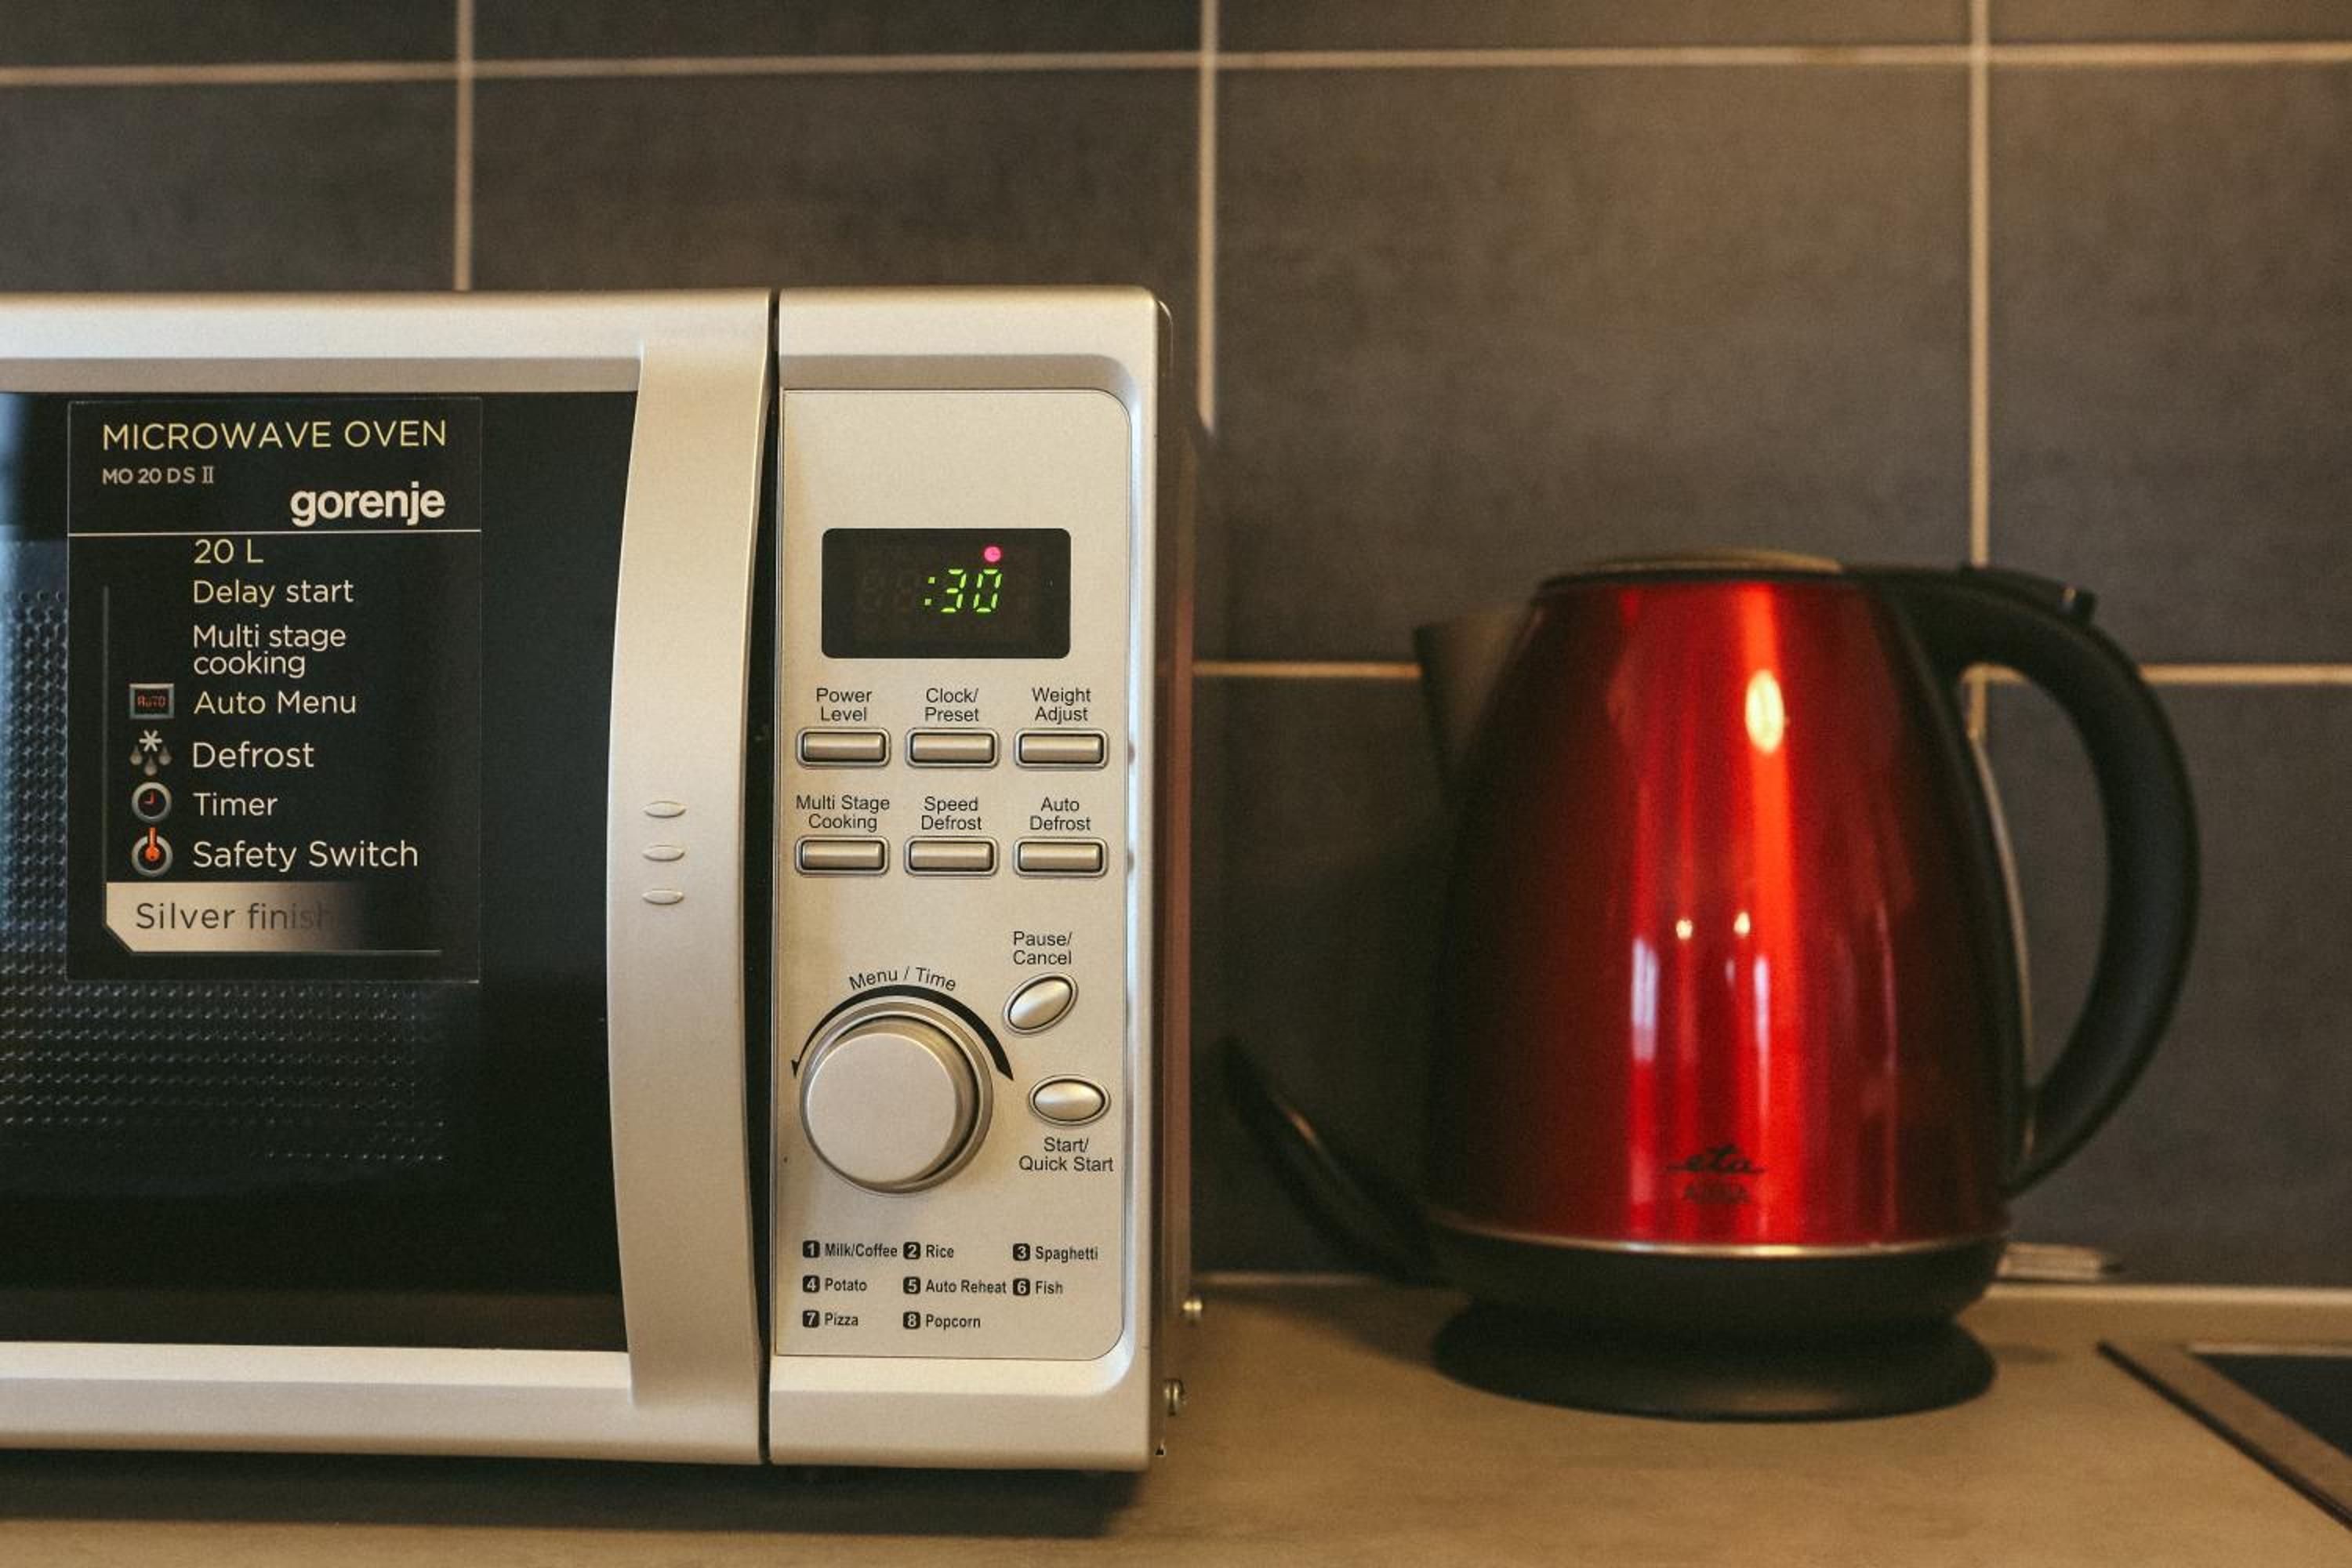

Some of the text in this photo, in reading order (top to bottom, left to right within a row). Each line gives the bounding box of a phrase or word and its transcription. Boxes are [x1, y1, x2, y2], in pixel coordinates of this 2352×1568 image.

[103, 419, 447, 451] MICROWAVE OVEN
[102, 468, 133, 485] MO
[137, 468, 162, 485] 20
[290, 481, 447, 527] gorenje
[194, 538, 264, 564] 20 L
[193, 579, 354, 608] Delay start
[193, 624, 347, 652] Multi stage
[193, 650, 306, 678] cooking
[194, 691, 358, 715] Auto Menu
[816, 688, 872, 703] Power
[926, 687, 979, 703] Clock/
[1032, 688, 1092, 706] Weight
[820, 706, 867, 722] Level
[924, 707, 980, 723] Preset
[1034, 707, 1089, 724] Adjust
[193, 742, 315, 769] Defrost
[193, 792, 278, 817] Timer
[796, 795, 891, 814] Multi Stage
[924, 797, 979, 815] Speed
[1040, 797, 1080, 812] Auto
[808, 814, 878, 833] Cooking
[921, 815, 982, 831] Defrost
[1029, 815, 1092, 831] Defrost
[193, 840, 419, 873] Safety Switch
[136, 902, 334, 931] Silver finish
[1013, 931, 1073, 947] Pause/
[1013, 950, 1073, 966] Cancel
[848, 967, 898, 991] Menu
[914, 967, 956, 992] Time
[1044, 1137, 1090, 1153] Start/
[1018, 1156, 1114, 1173] Quick Start
[824, 1243, 898, 1258] Milk/Coffee
[906, 1243, 954, 1258] 2 Rice
[1015, 1245, 1098, 1262] 3 Spaghetti
[805, 1277, 868, 1292] 4 Potato
[906, 1279, 1007, 1294] 5 Auto Reheat
[1015, 1280, 1064, 1295] 6 Fish
[805, 1312, 859, 1327] 7 Pizza
[906, 1313, 982, 1330] 8 Popcorn
